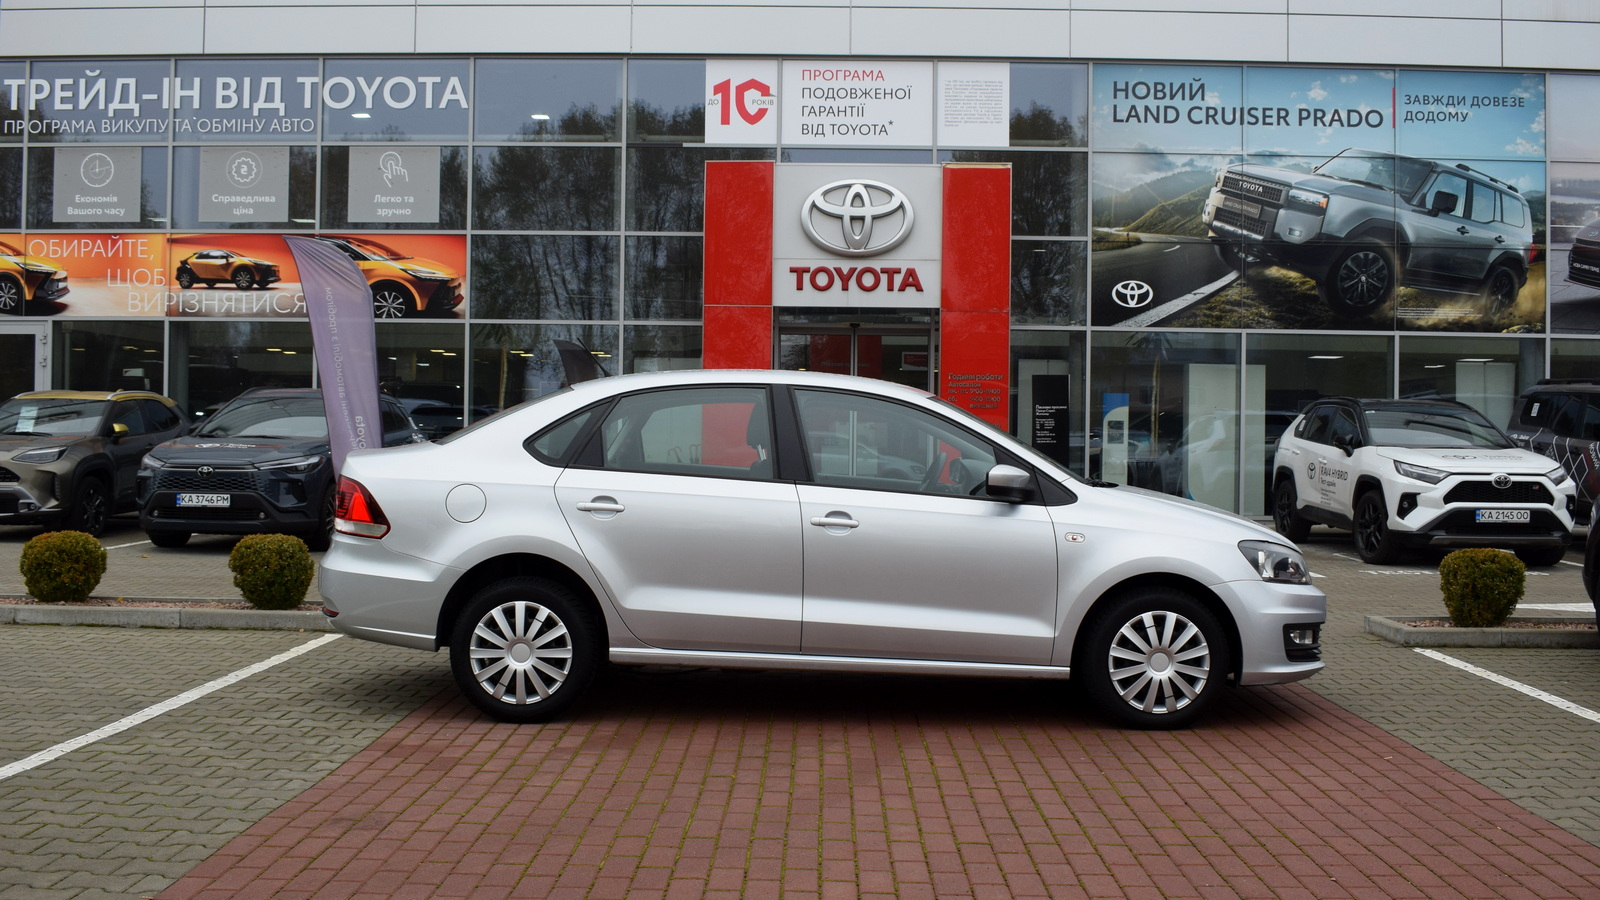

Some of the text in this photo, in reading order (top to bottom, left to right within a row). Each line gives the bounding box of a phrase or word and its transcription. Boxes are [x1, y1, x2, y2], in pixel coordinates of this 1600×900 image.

[802, 69, 885, 81] ПРОГРАМА
[4, 69, 468, 117] ТРЕЙД-ІН ВІД TOYOTA
[802, 85, 912, 101] ПОДОВЖЕНОЇ
[1113, 77, 1205, 101] НОВИЙ
[708, 98, 719, 106] ДО
[1404, 94, 1525, 108] ЗАВЖДИ ДОВЕЗЕ
[801, 103, 866, 117] ГАРАНТІЇ
[1113, 104, 1384, 129] LAND CRUISER PRADO
[1404, 110, 1469, 123] ДОДОМУ
[4, 118, 315, 134] ПРОГРАМА ВИКУПУ ТА ОБМІНУ АВТО
[801, 123, 826, 137] ВІД
[1239, 181, 1263, 193] TOYOTA
[75, 194, 118, 203] Економія
[212, 194, 276, 204] Справедлива
[374, 194, 402, 203] Легко
[67, 207, 125, 216] Вашого часу
[233, 206, 254, 215] ціна
[376, 208, 411, 217] зручно
[28, 235, 155, 261] ОБИРАЙТЕ,
[107, 268, 166, 289] ЩОБ
[789, 266, 924, 292] TOYOTA
[128, 292, 307, 314] ВИРІЗНЯТИСЯ
[948, 372, 1003, 381] Години роботи
[181, 494, 230, 505] KA 3746 PM
[1480, 511, 1494, 520] KA
[1495, 511, 1515, 520] 2145
